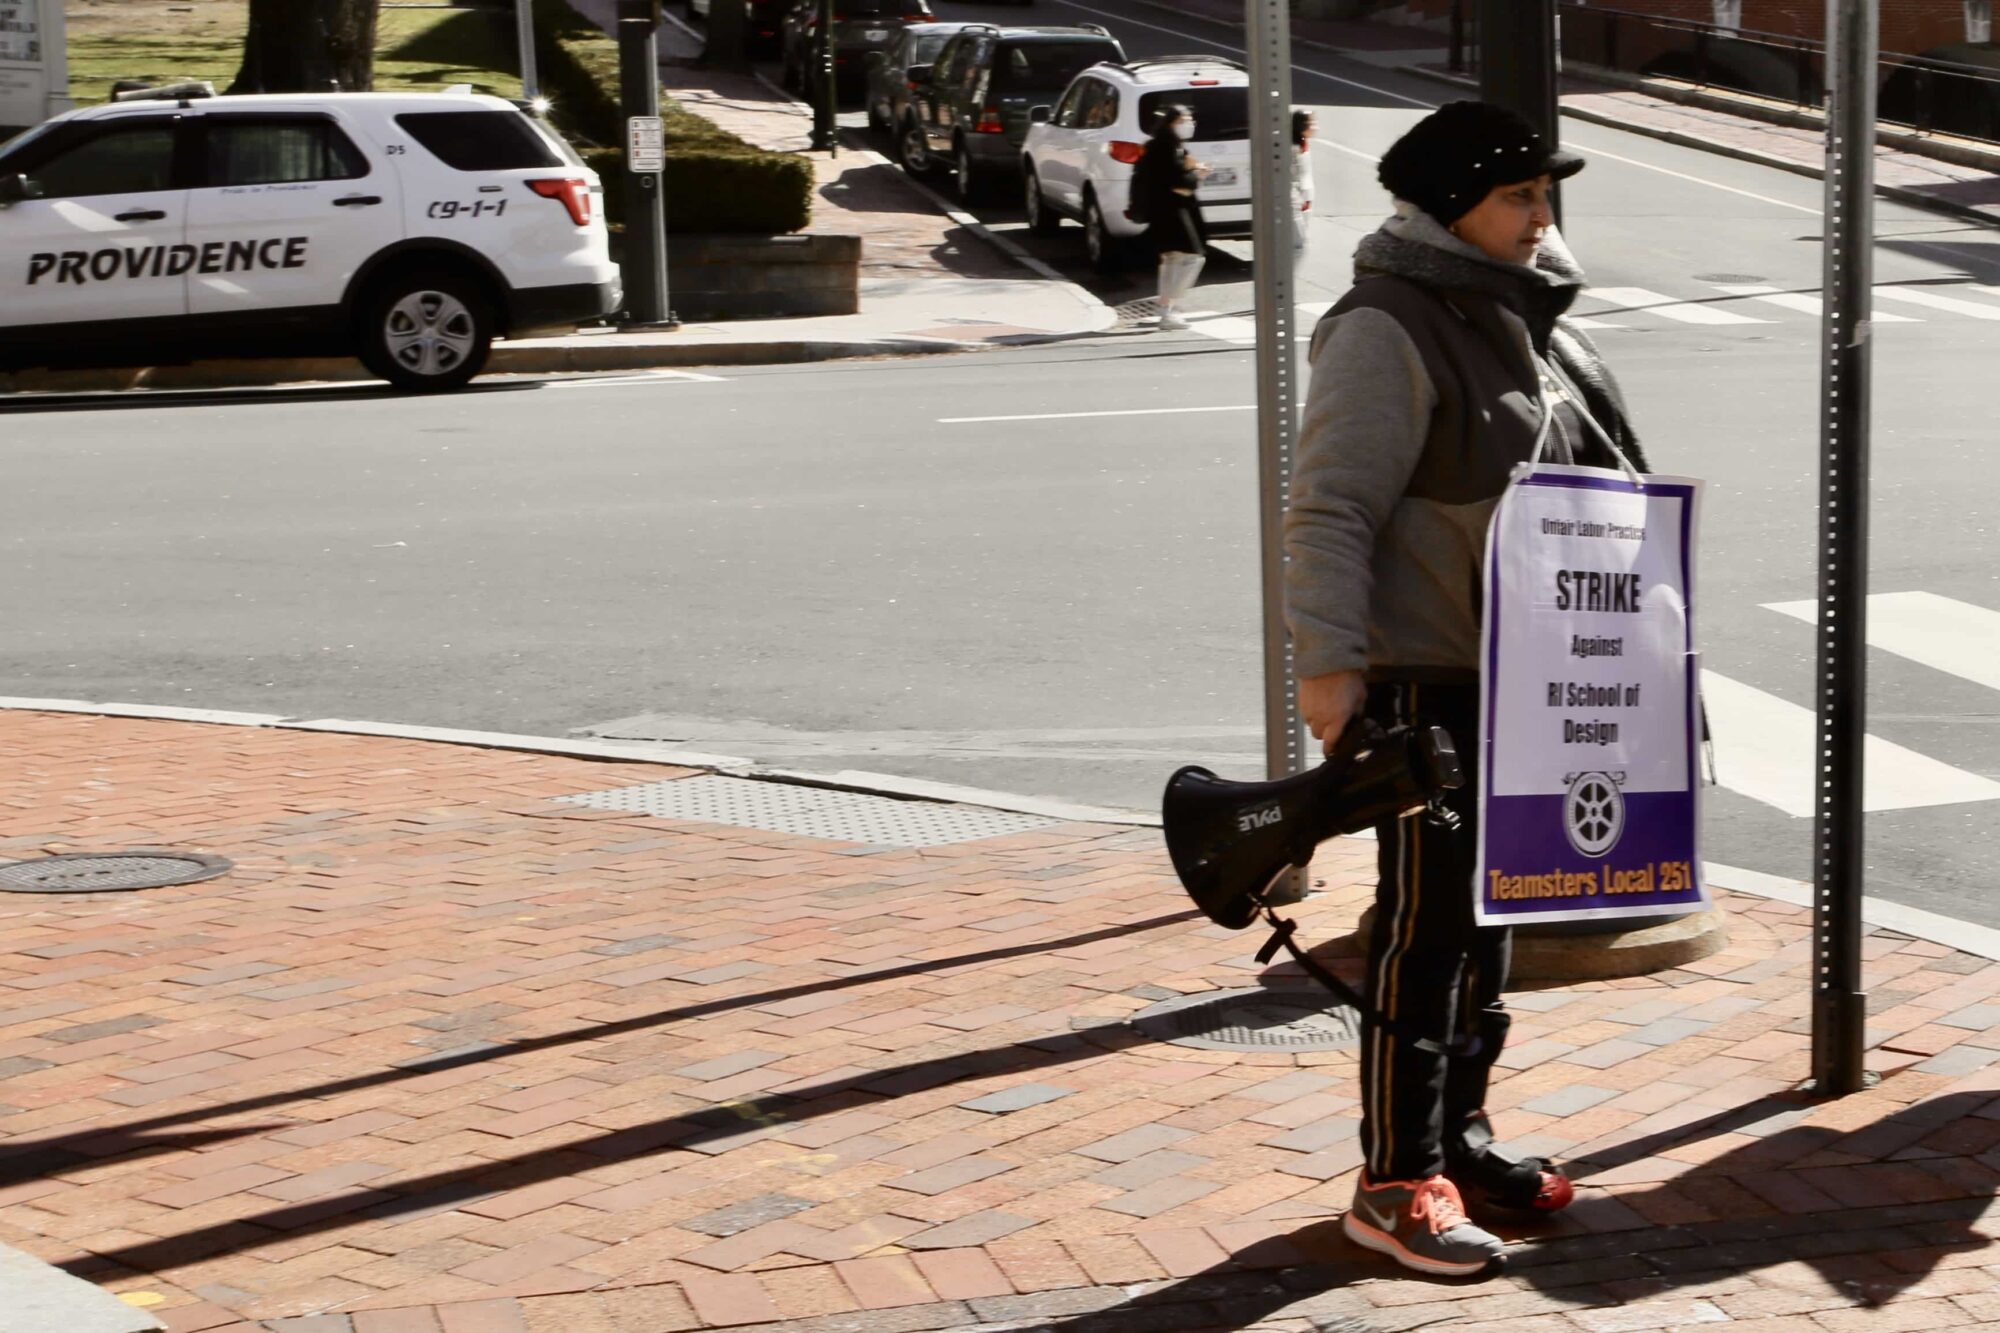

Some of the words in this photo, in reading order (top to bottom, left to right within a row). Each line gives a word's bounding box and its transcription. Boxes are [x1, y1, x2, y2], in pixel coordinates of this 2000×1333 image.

[26, 236, 309, 285] PROVIDENCE
[1556, 569, 1642, 613] STRIKE
[1570, 635, 1624, 658] Against
[1547, 682, 1563, 707] RI
[1566, 682, 1621, 707] School
[1625, 683, 1641, 707] of
[1563, 718, 1619, 746] Design
[1238, 805, 1283, 832] PYLE
[1488, 868, 1597, 900] Teamsters
[1602, 863, 1655, 894] Local
[1659, 861, 1692, 891] 251
